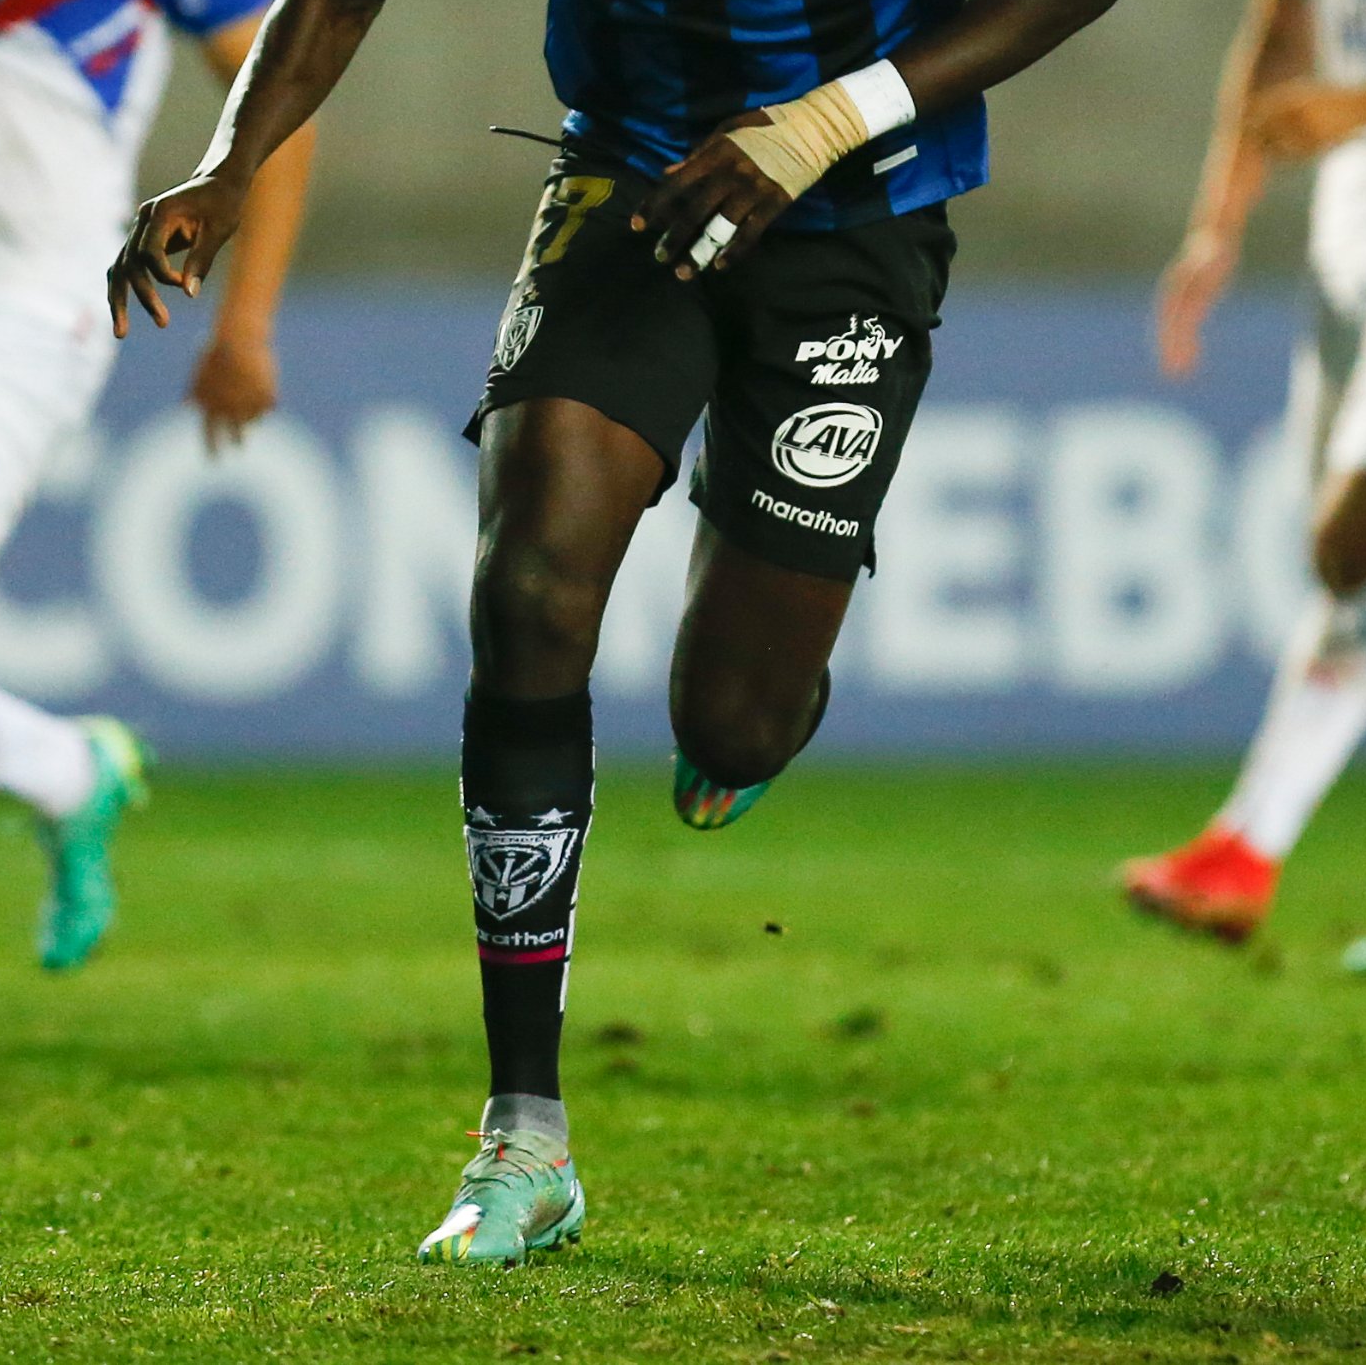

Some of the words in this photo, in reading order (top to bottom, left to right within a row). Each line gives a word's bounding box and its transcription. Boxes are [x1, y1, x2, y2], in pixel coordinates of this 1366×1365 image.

[795, 336, 903, 362] PONY
[811, 359, 880, 385] Malta
[779, 415, 878, 463] LAVA
[752, 489, 860, 537] marathon
